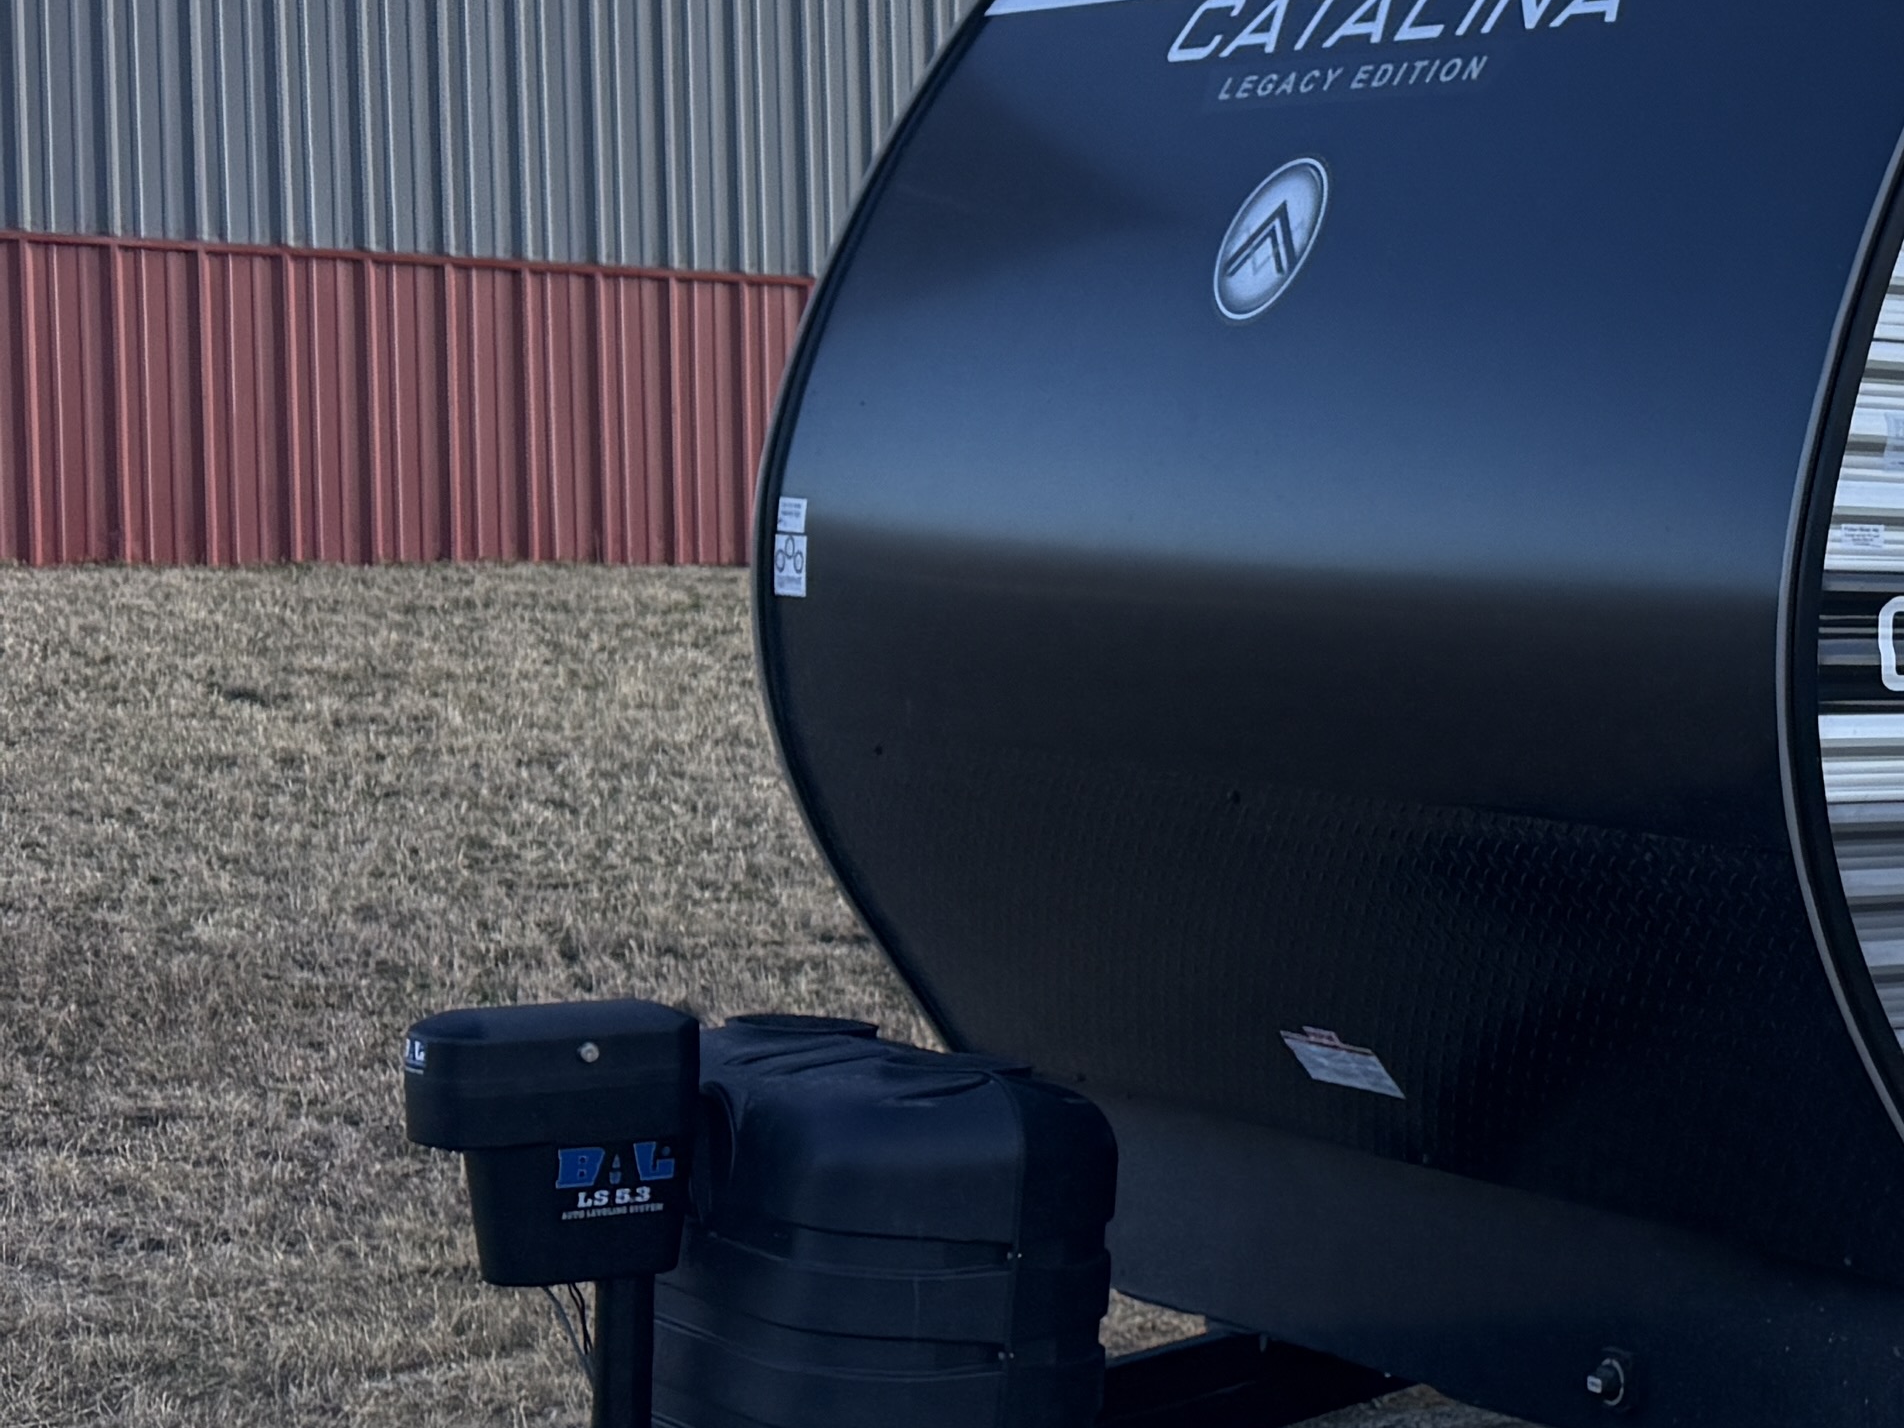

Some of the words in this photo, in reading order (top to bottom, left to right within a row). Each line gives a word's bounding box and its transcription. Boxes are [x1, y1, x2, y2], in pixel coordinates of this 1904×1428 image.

[1217, 66, 1344, 102] LEGACY
[1350, 53, 1489, 91] EDITION
[578, 1190, 609, 1208] LS
